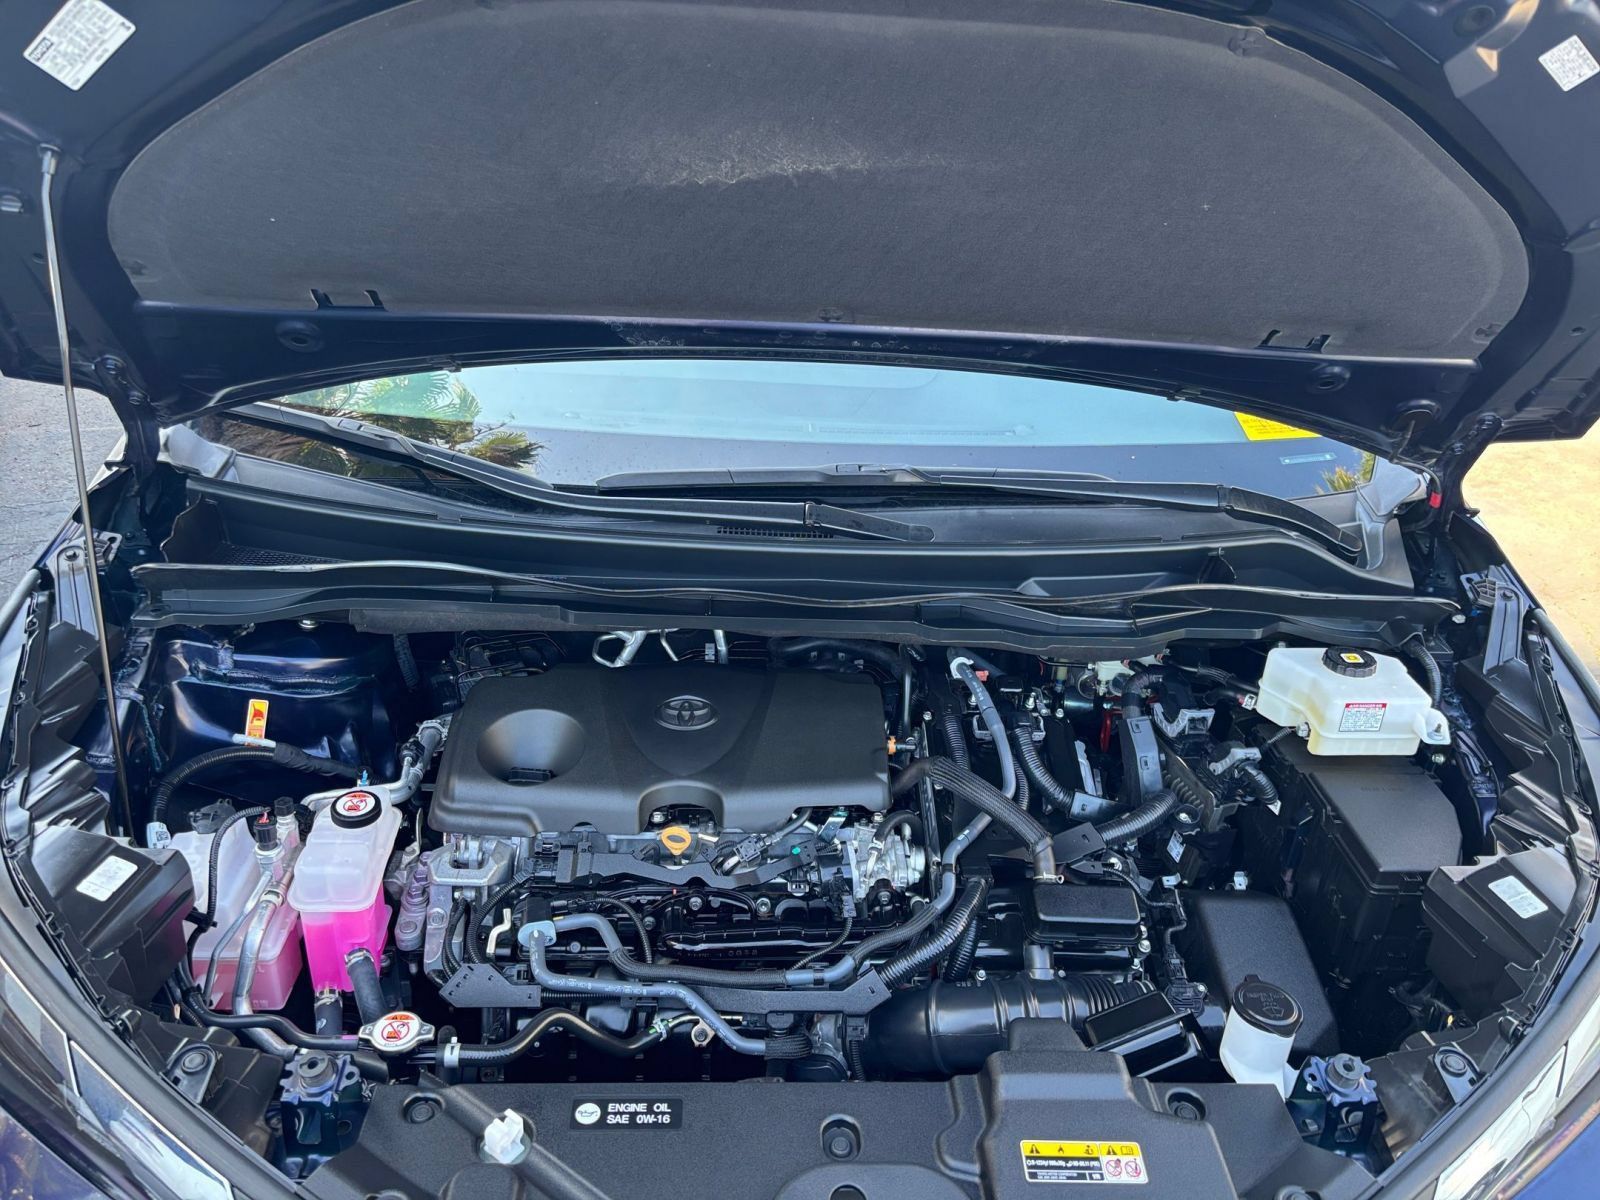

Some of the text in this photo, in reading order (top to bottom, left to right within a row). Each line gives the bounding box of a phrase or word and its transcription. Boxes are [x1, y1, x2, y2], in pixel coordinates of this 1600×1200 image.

[608, 1103, 672, 1113] ENGINE OIL
[606, 1114, 671, 1124] SAE 0W-16
